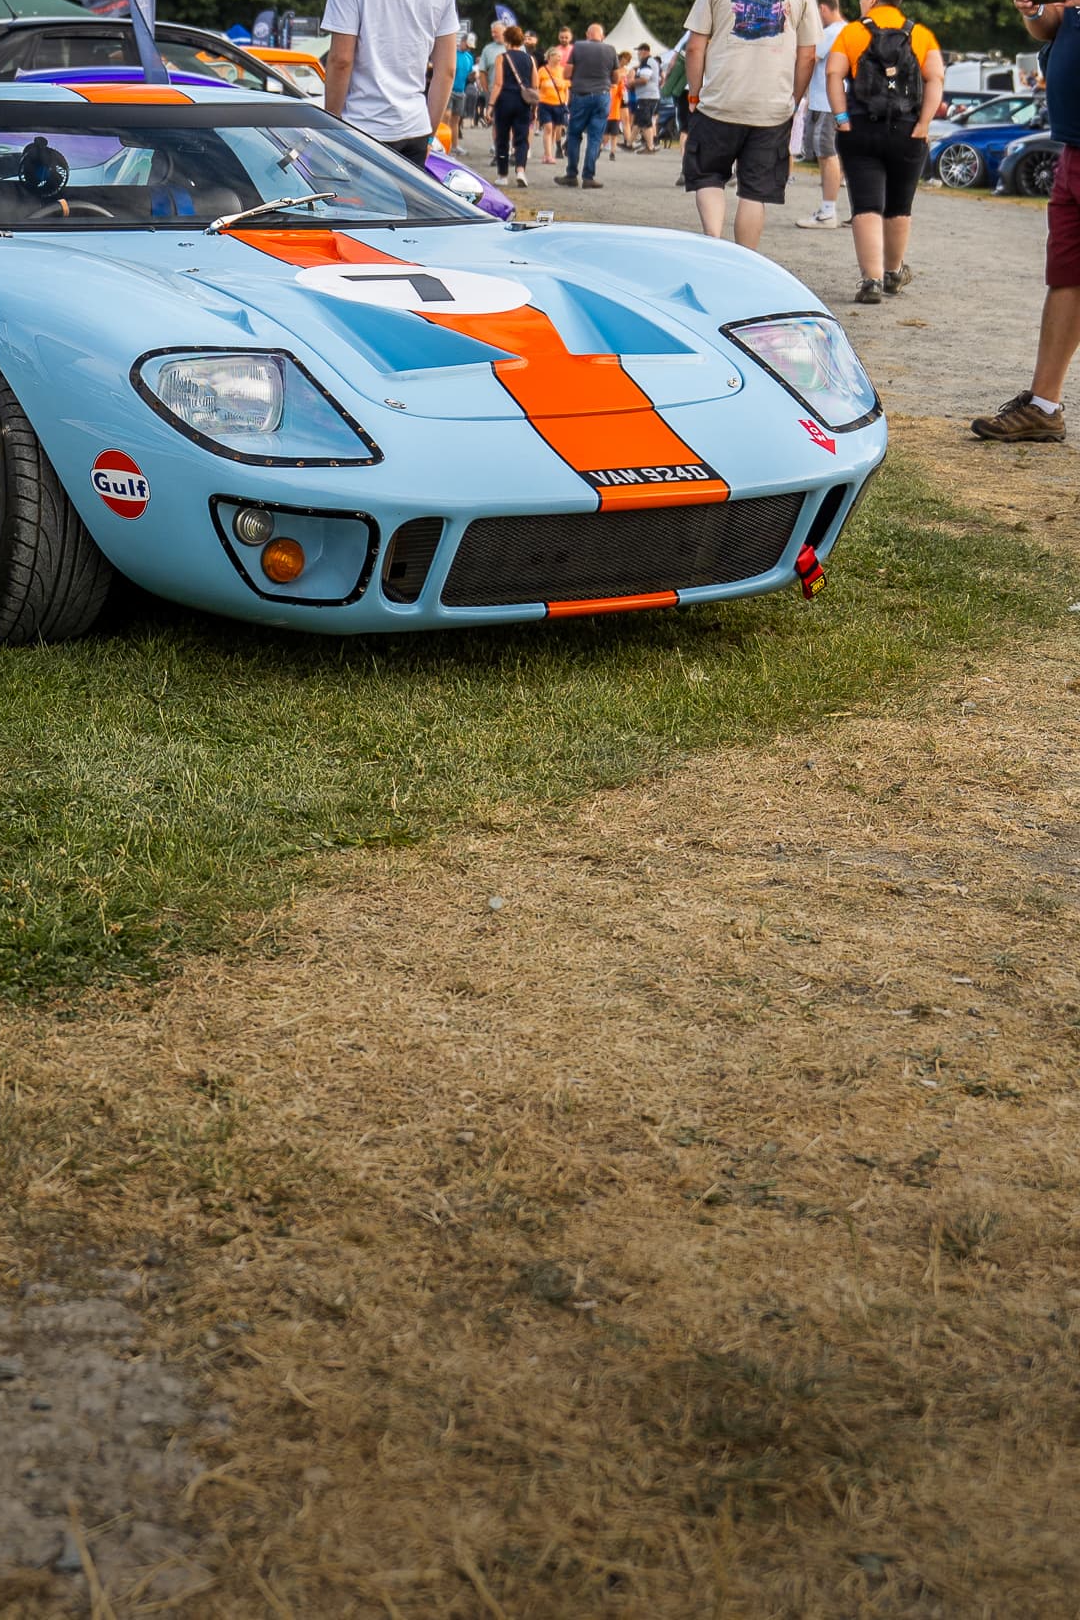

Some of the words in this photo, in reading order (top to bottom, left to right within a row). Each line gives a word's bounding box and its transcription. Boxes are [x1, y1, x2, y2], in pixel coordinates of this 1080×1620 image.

[339, 273, 456, 302] 7
[802, 419, 827, 442] TOW
[93, 472, 147, 498] Gulf
[588, 469, 644, 485] VAM
[640, 465, 710, 482] 924D
